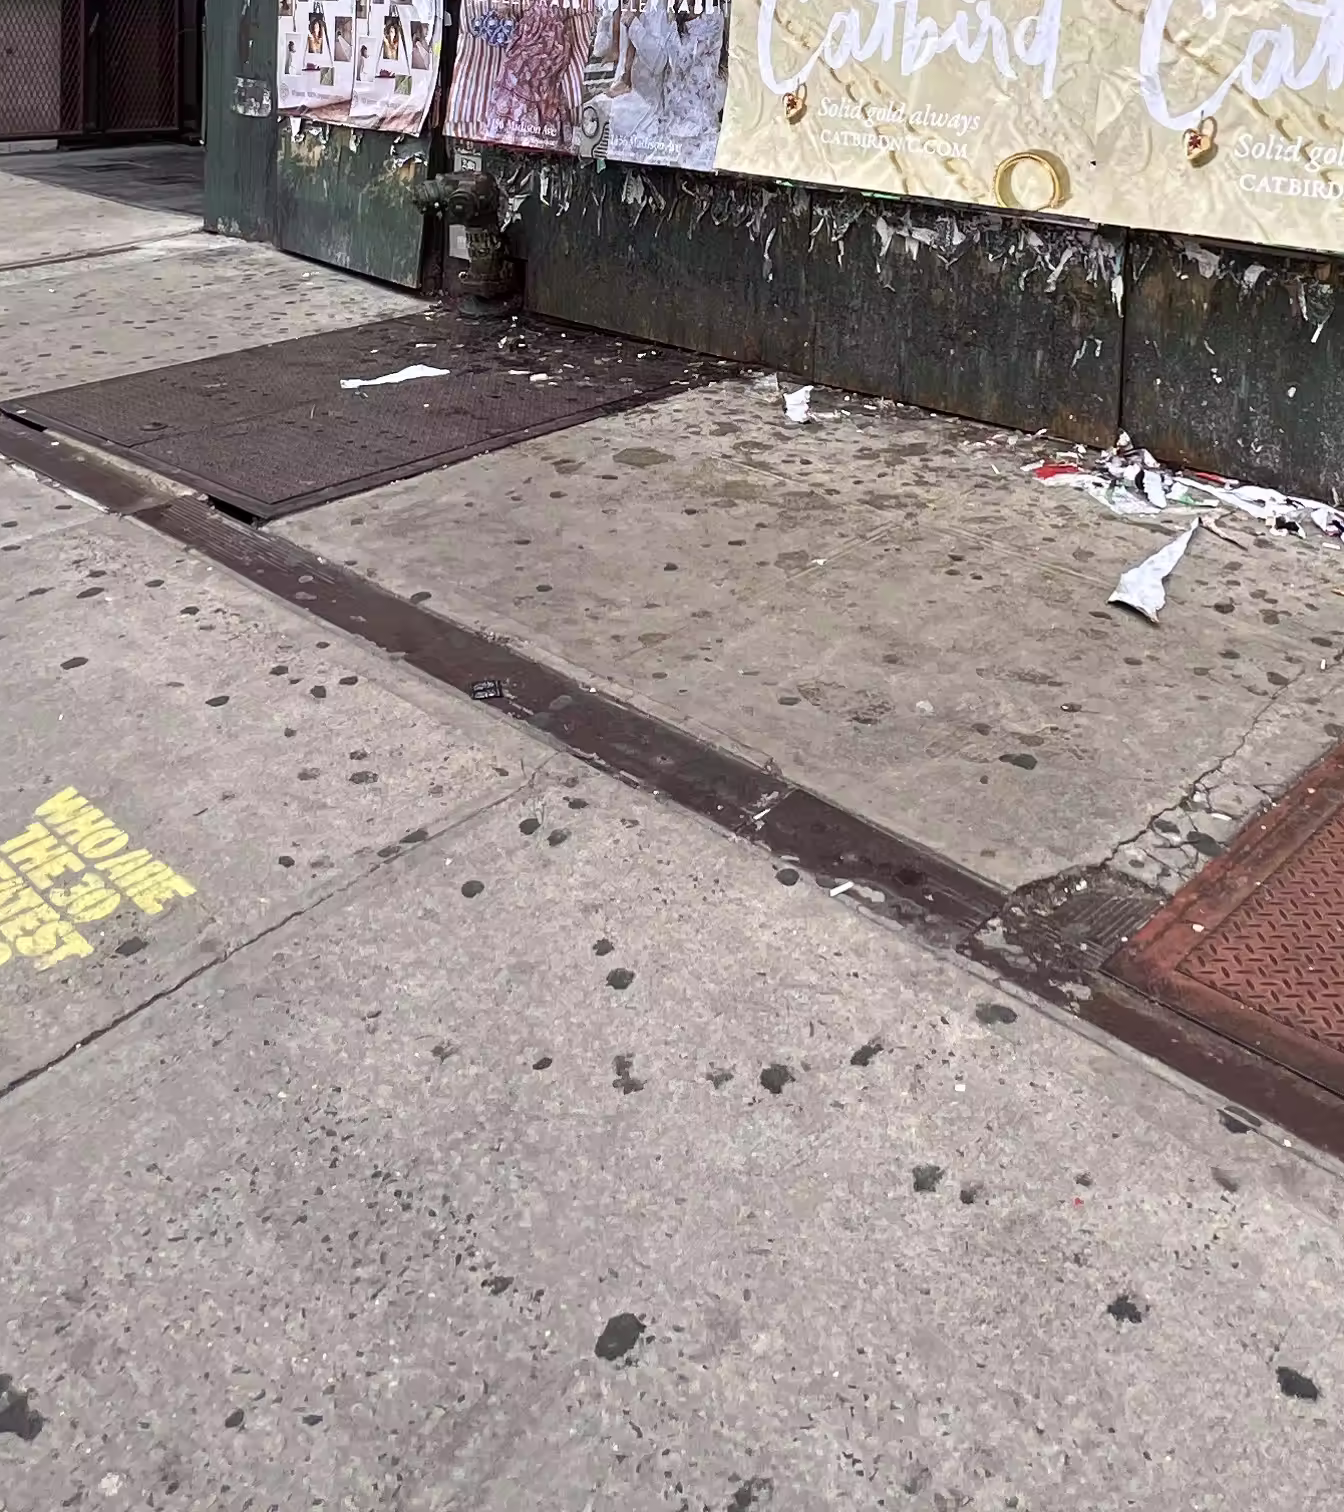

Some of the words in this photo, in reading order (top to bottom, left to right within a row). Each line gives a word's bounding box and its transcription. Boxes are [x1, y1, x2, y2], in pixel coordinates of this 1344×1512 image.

[818, 97, 863, 120] Solid
[909, 103, 981, 136] always
[1235, 133, 1302, 163] Solid
[0, 821, 85, 890] THE
[49, 872, 121, 924] 30
[34, 785, 129, 859] WHO
[94, 848, 197, 915] ARE
